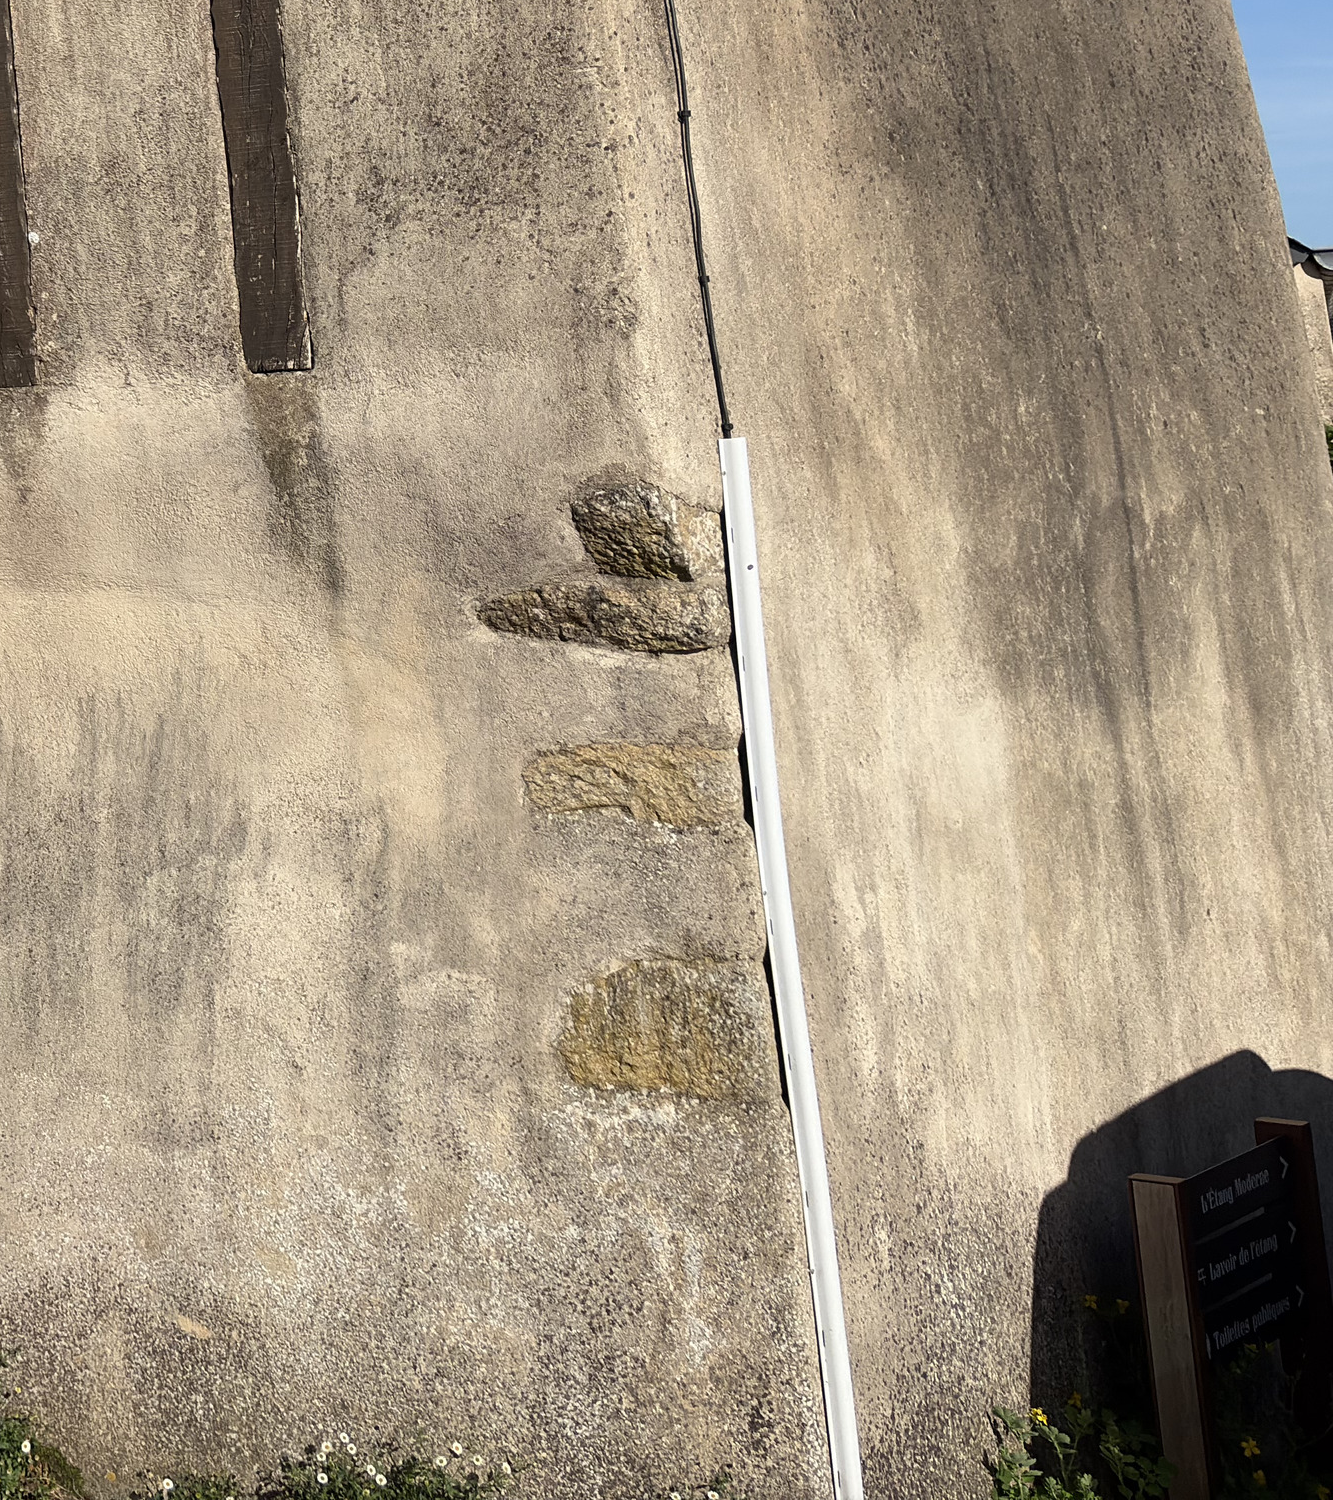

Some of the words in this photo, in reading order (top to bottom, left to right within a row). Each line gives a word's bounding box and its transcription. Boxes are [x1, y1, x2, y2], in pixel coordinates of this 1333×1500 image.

[1200, 1186, 1234, 1215] L'Étang
[1234, 1168, 1270, 1198] Moderne
[1208, 1253, 1237, 1282] Lavoir
[1238, 1246, 1250, 1266] de
[1212, 1317, 1251, 1351] Toilettes
[1252, 1296, 1291, 1333] publiques
